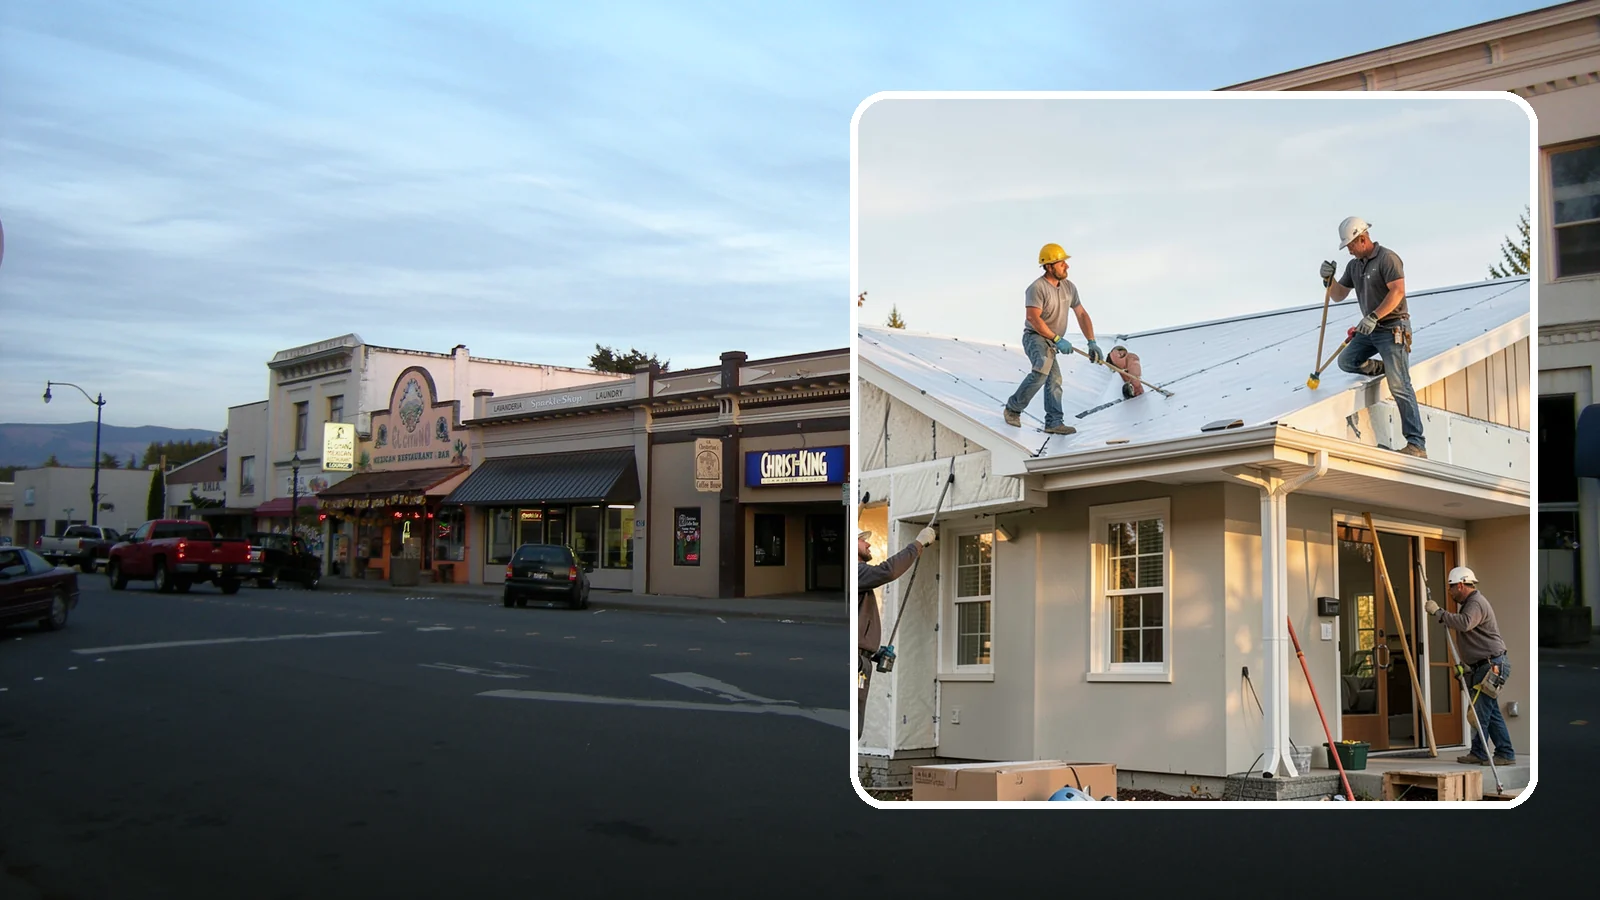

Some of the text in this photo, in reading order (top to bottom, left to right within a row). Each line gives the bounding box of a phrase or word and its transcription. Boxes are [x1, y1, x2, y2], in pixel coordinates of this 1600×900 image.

[595, 388, 624, 400] LAUNDRY
[493, 402, 523, 413] LAVANDERIA
[530, 394, 583, 409] Sparkle Shop
[373, 455, 396, 464] MEXICAN
[397, 451, 434, 462] RESTAURANT
[438, 450, 450, 459] BAR
[761, 452, 797, 478] CHRIST
[799, 450, 827, 476] KING
[696, 481, 710, 489] Coffee
